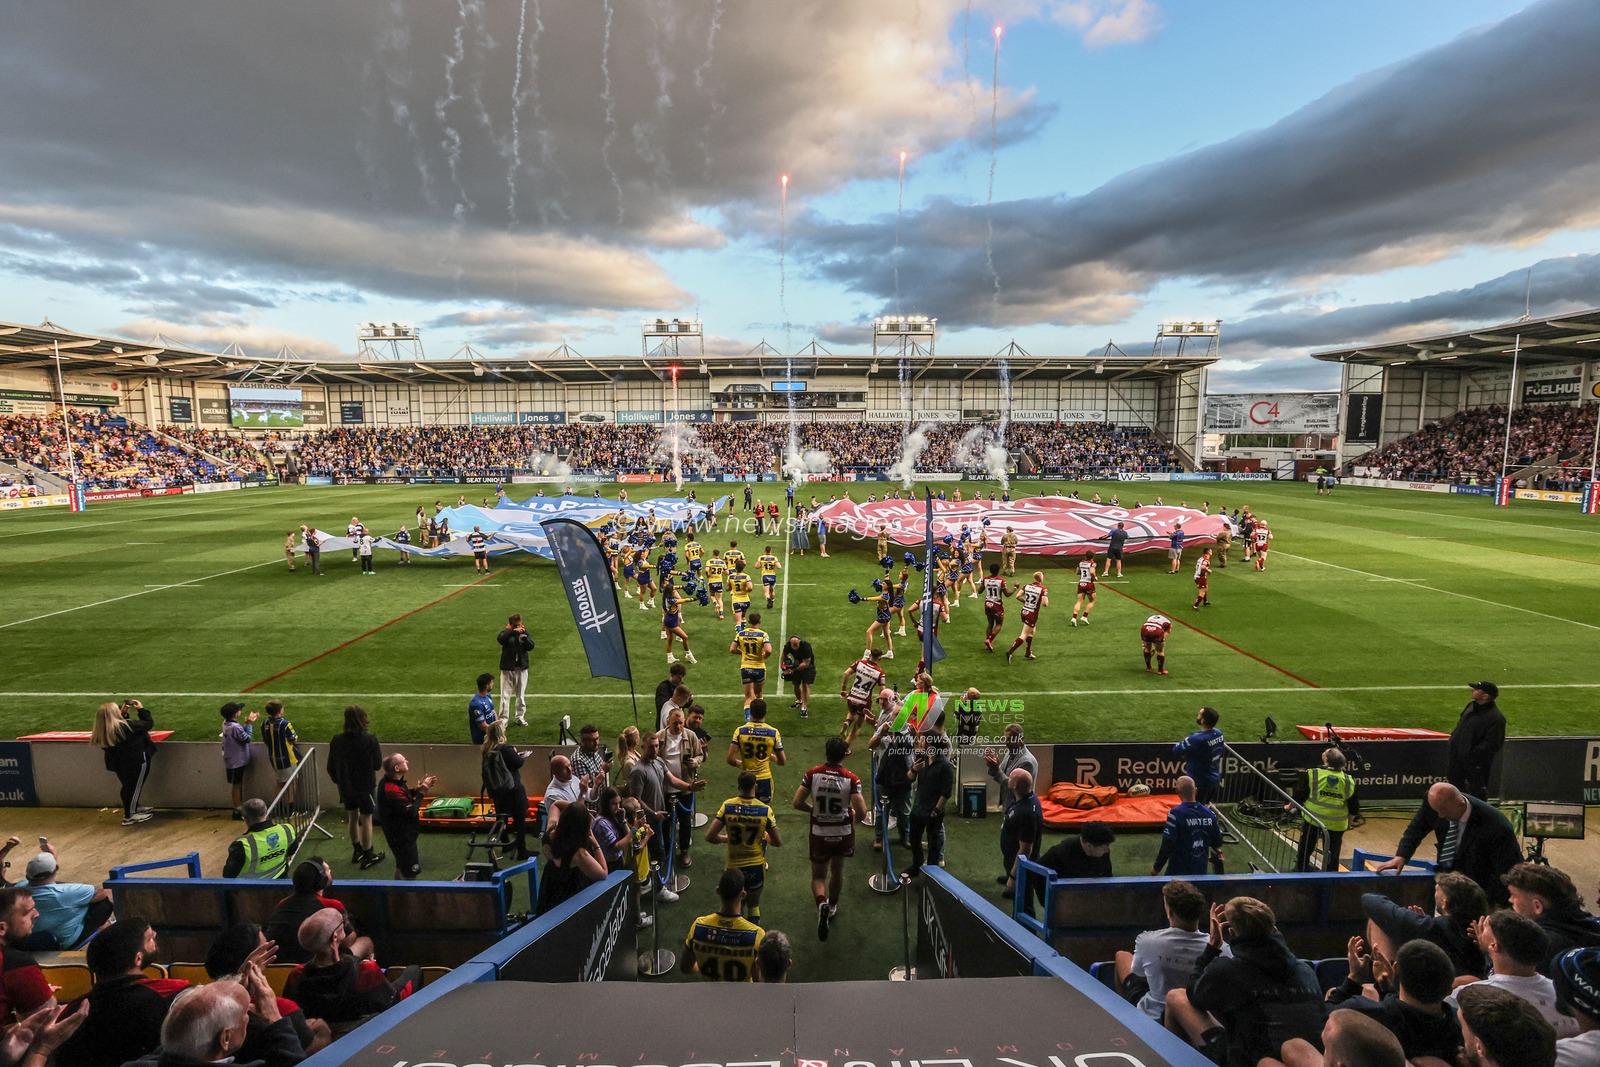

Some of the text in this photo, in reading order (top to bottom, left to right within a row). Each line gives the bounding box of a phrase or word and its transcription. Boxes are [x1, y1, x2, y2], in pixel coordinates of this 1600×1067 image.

[475, 414, 549, 422] Halliwell Jones
[621, 412, 696, 421] Halliwell Jones
[825, 413, 862, 421] Warrington
[988, 588, 998, 597] 11
[1025, 594, 1037, 604] 22
[744, 643, 757, 654] 11
[854, 676, 872, 693] 24
[744, 742, 767, 760] 38
[1226, 757, 1278, 773] Bank
[1320, 790, 1343, 799] ROSS
[816, 796, 842, 814] 16
[1186, 818, 1213, 826] WATER
[730, 826, 759, 846] 37
[260, 848, 285, 862] ROSS
[588, 885, 630, 982] scalator
[700, 957, 747, 982] 40
